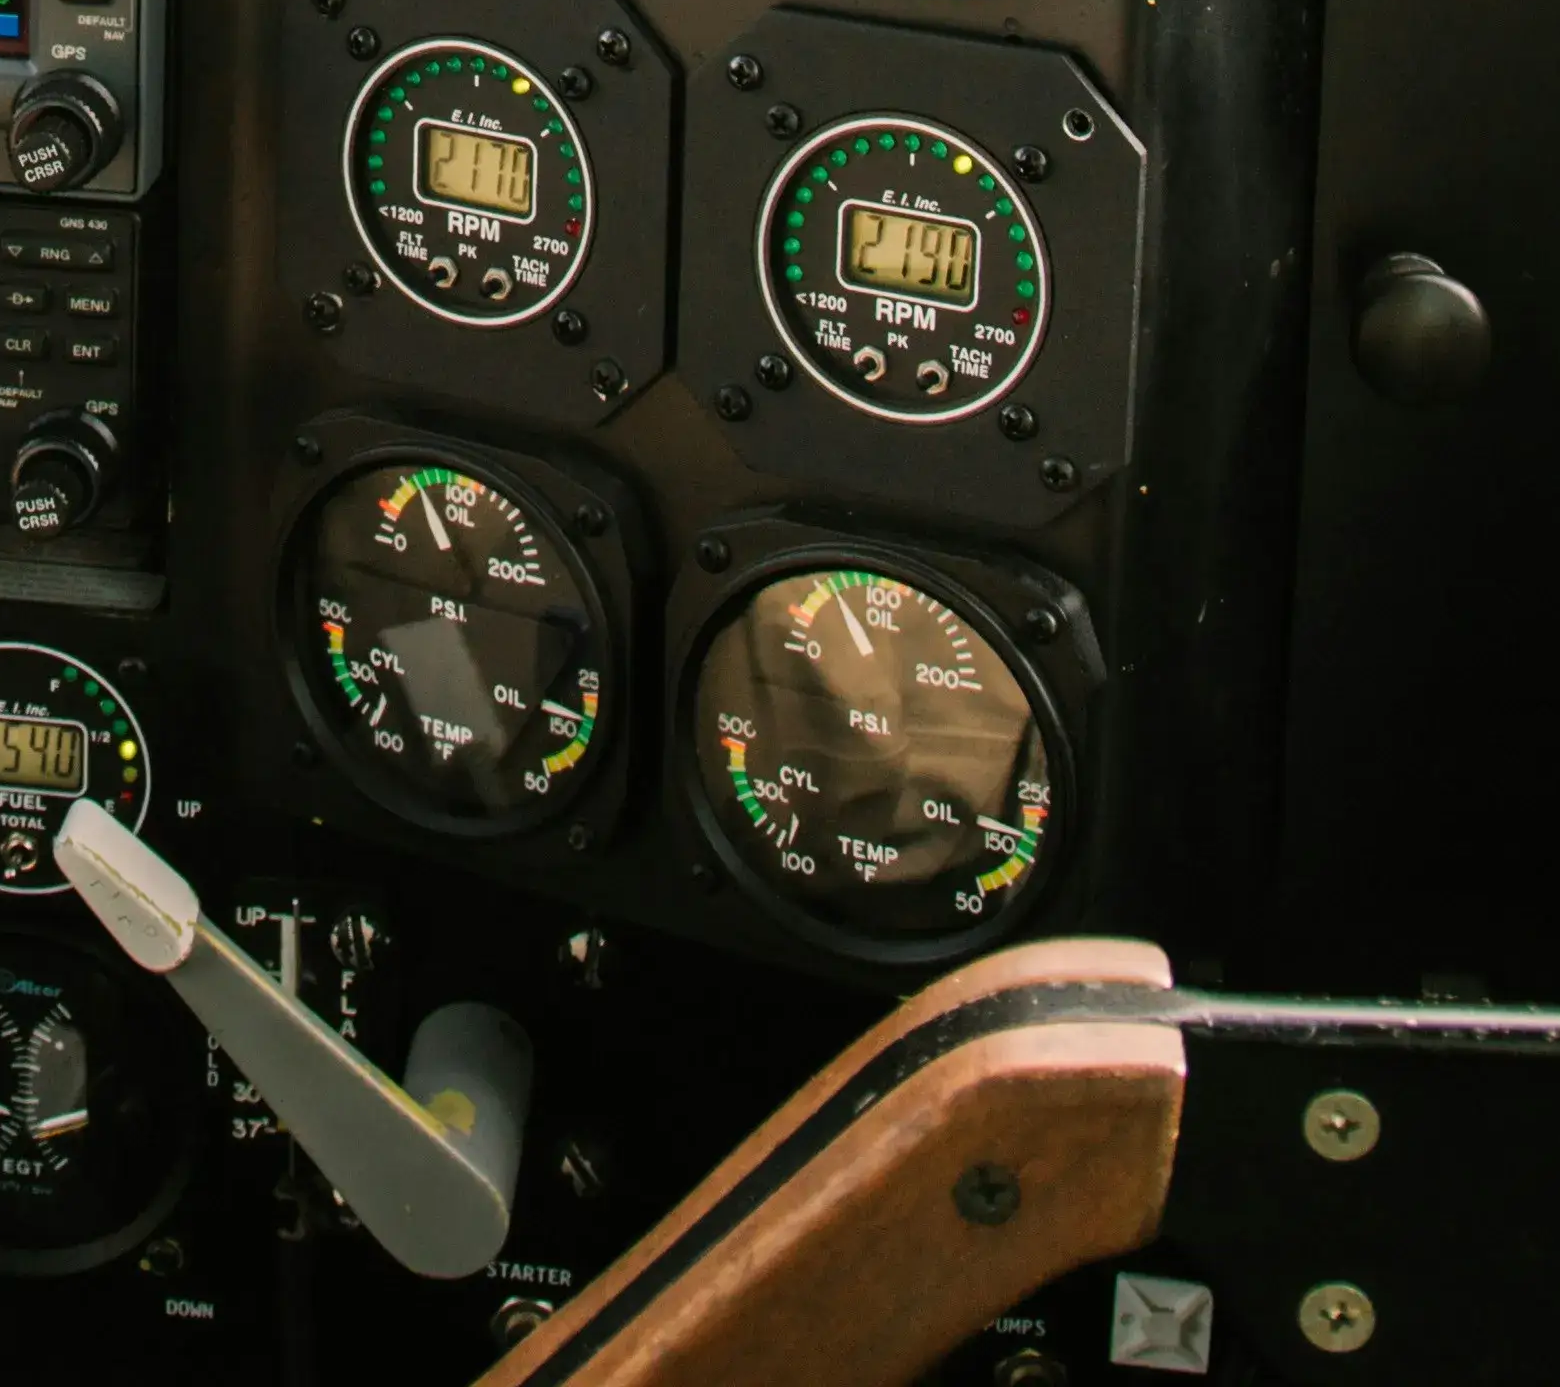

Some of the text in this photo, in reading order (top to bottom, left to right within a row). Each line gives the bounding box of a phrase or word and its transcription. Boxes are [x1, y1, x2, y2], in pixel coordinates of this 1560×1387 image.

[447, 213, 501, 244] RPM
[875, 298, 937, 331] RPM
[974, 326, 1015, 345] 2700
[72, 344, 102, 358] ENT
[431, 598, 467, 621] P.S.I.
[865, 609, 901, 630] OIL
[420, 715, 472, 742] TEMP
[780, 766, 820, 790] CYL
[177, 799, 201, 817] UP
[165, 1299, 215, 1320] DOWN
